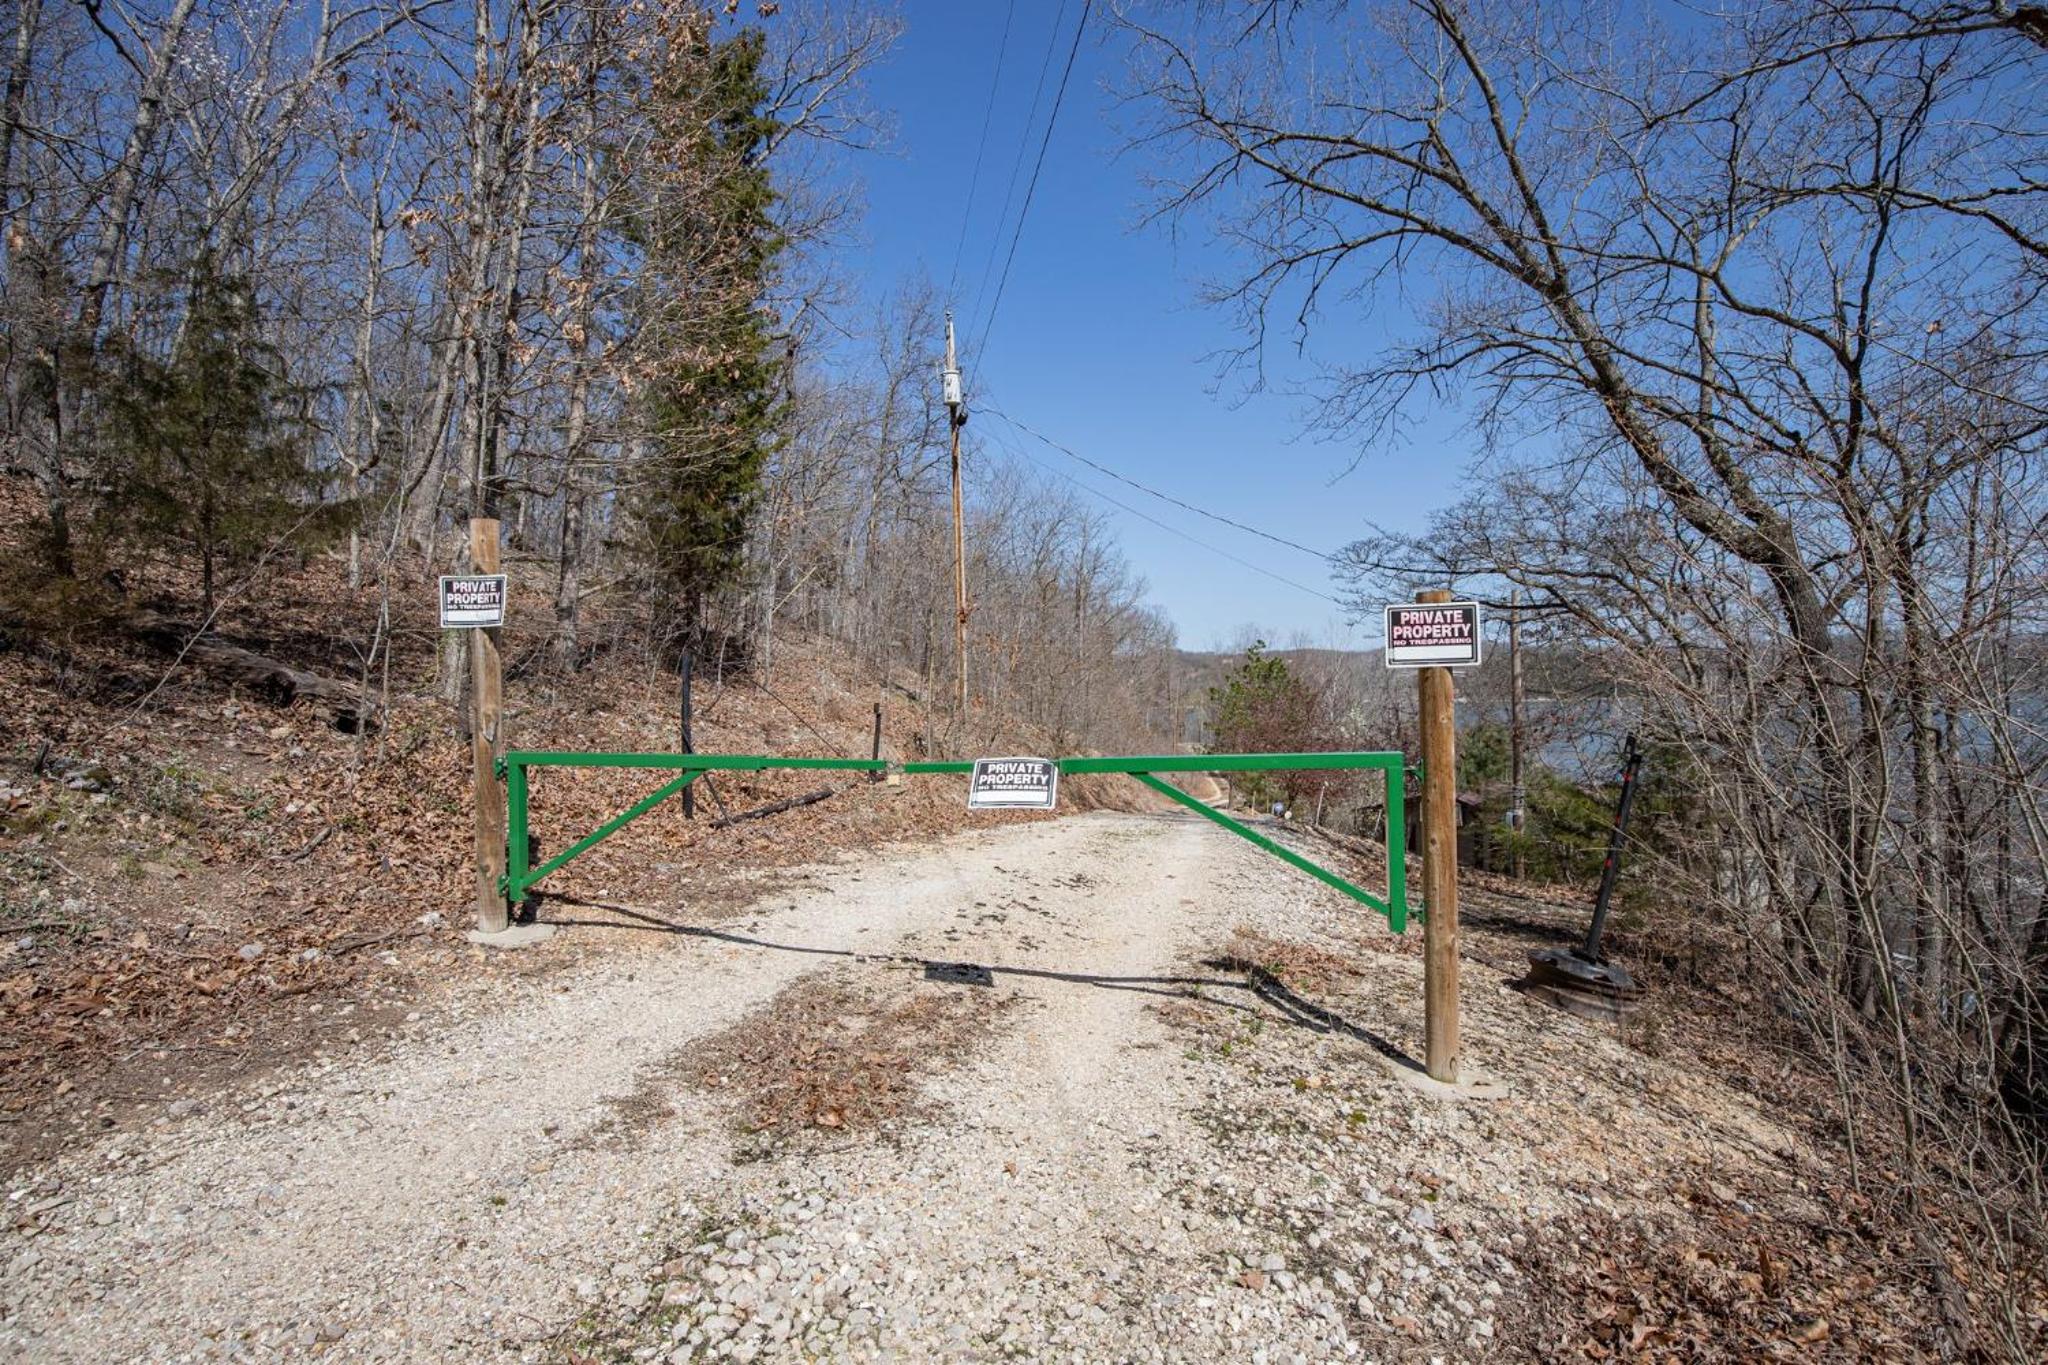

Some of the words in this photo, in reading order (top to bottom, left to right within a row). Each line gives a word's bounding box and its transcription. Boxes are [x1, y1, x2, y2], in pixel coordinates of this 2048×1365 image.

[452, 581, 497, 593] PRIVATE
[447, 592, 501, 604] PROPERTY
[1400, 610, 1463, 625] PRIVATE
[1393, 624, 1471, 639] PROPERTY
[1408, 638, 1472, 646] TRESPASSING
[988, 763, 1043, 774] PRIVATE
[979, 774, 1049, 785] PROPERTY
